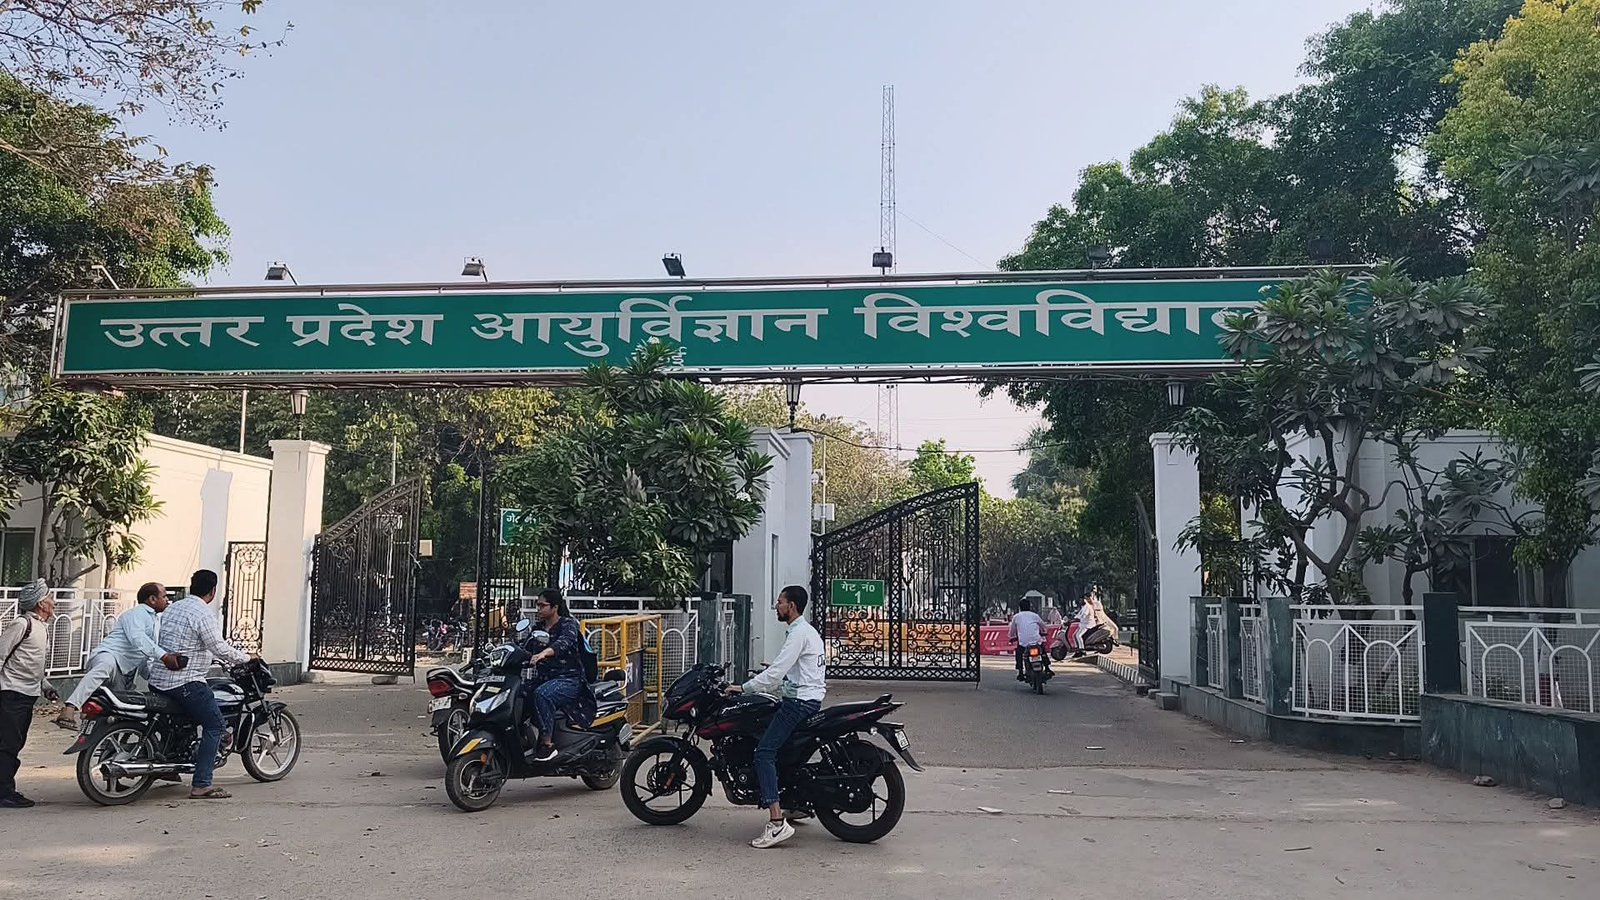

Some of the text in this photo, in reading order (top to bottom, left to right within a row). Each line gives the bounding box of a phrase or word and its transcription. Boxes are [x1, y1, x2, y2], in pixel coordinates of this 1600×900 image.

[100, 316, 265, 348] उत्तर
[286, 303, 444, 347] प्रदेश
[470, 295, 829, 357] आयुर्विज्ञान
[841, 581, 856, 592] गेट
[855, 591, 861, 603] 1
